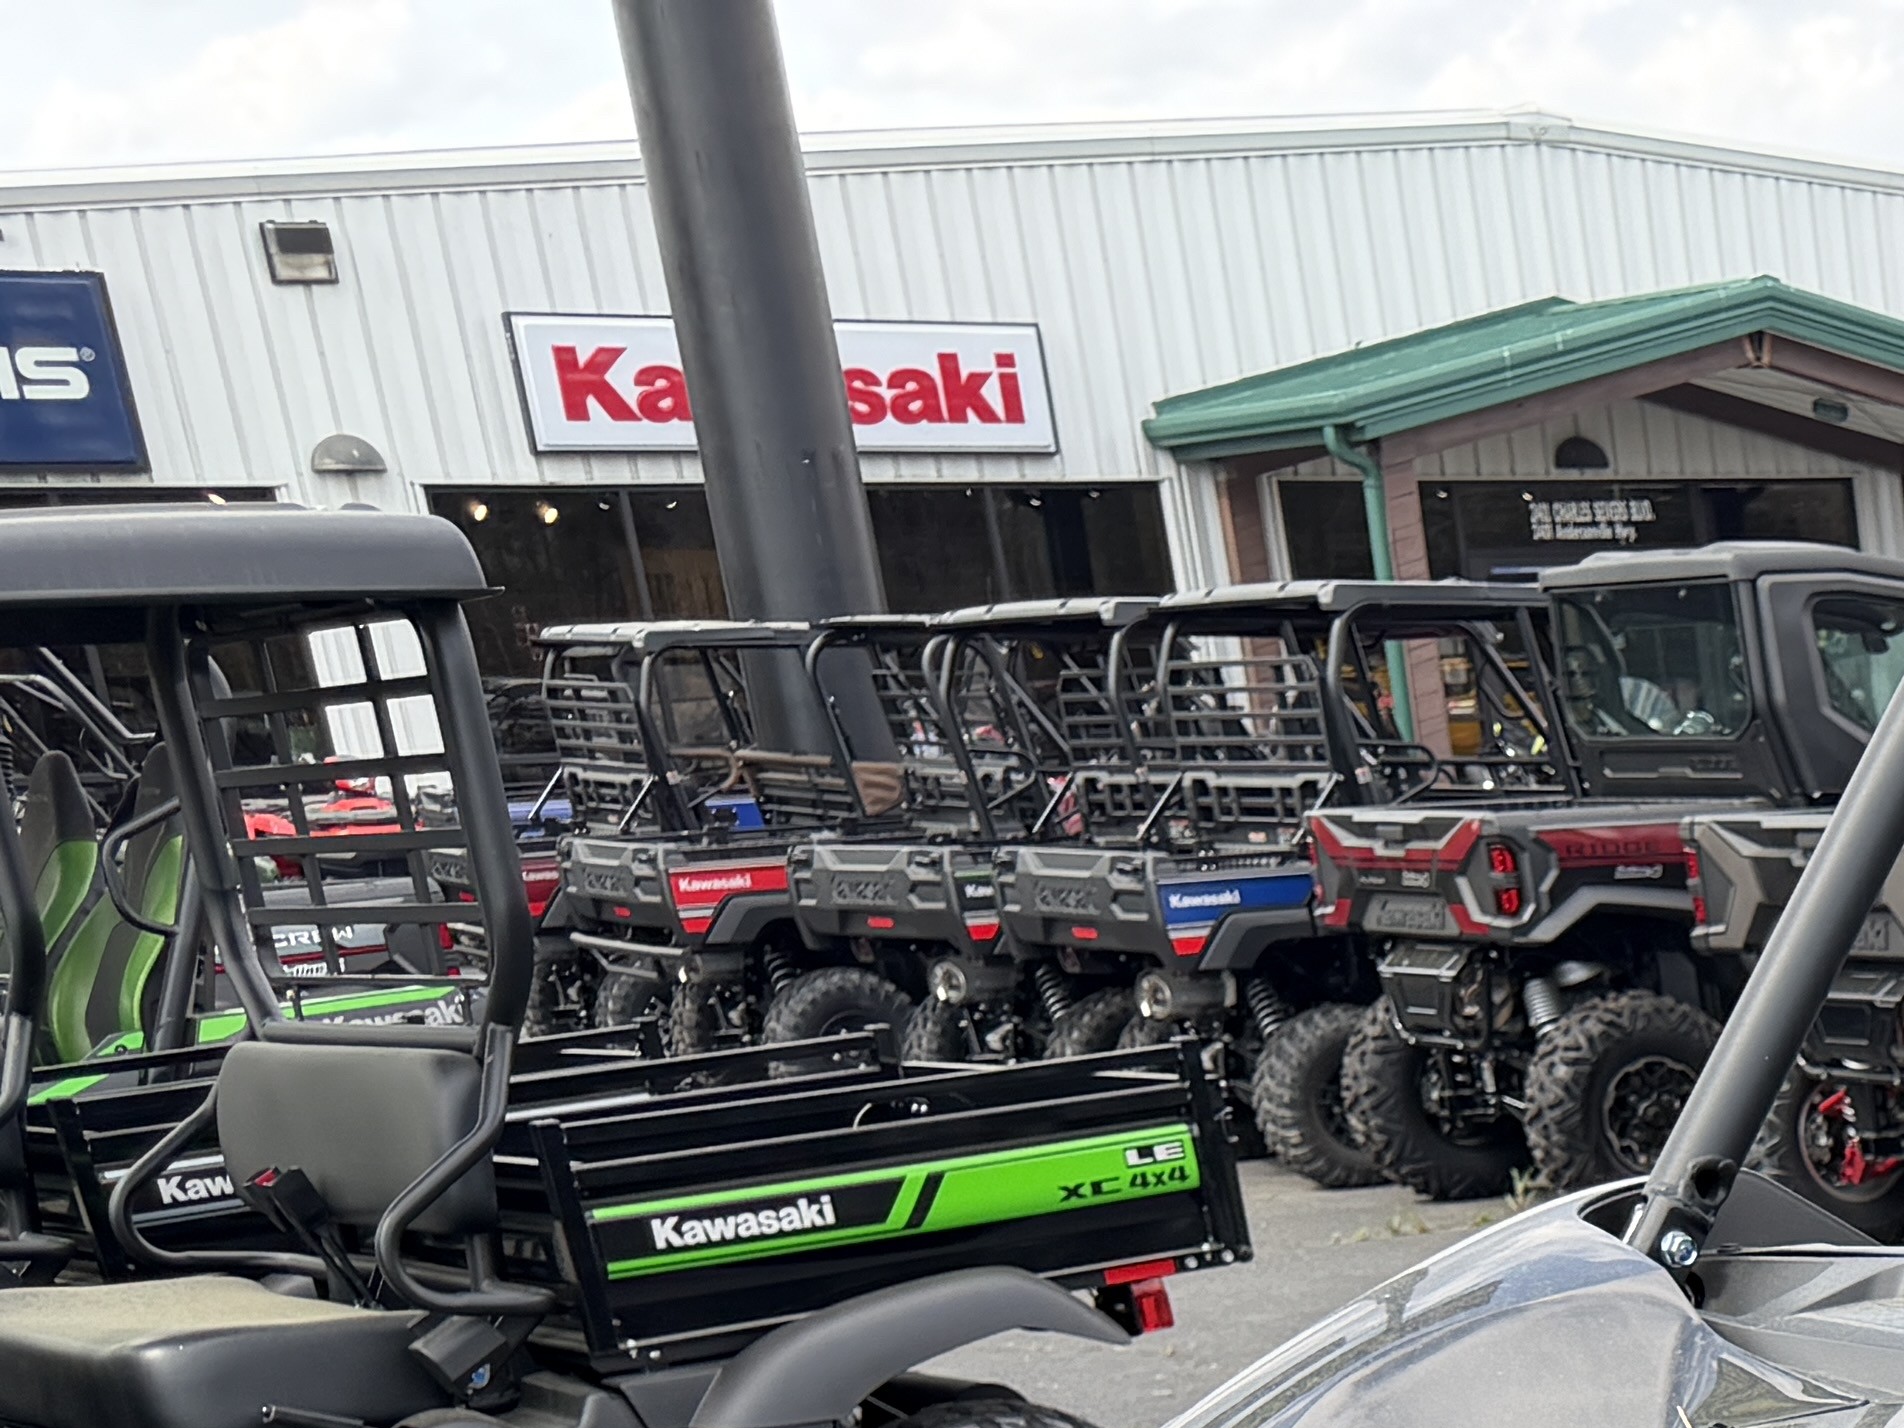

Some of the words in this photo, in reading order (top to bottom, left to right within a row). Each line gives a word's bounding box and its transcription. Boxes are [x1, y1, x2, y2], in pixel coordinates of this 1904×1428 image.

[552, 344, 1025, 426] Kasaki
[678, 873, 752, 893] Kawasaki
[1168, 888, 1242, 909] Kawasaki
[1125, 1142, 1185, 1167] LE
[1057, 1177, 1123, 1204] XC
[1127, 1165, 1191, 1192] 4x4
[650, 1195, 837, 1250] Kawasaki
